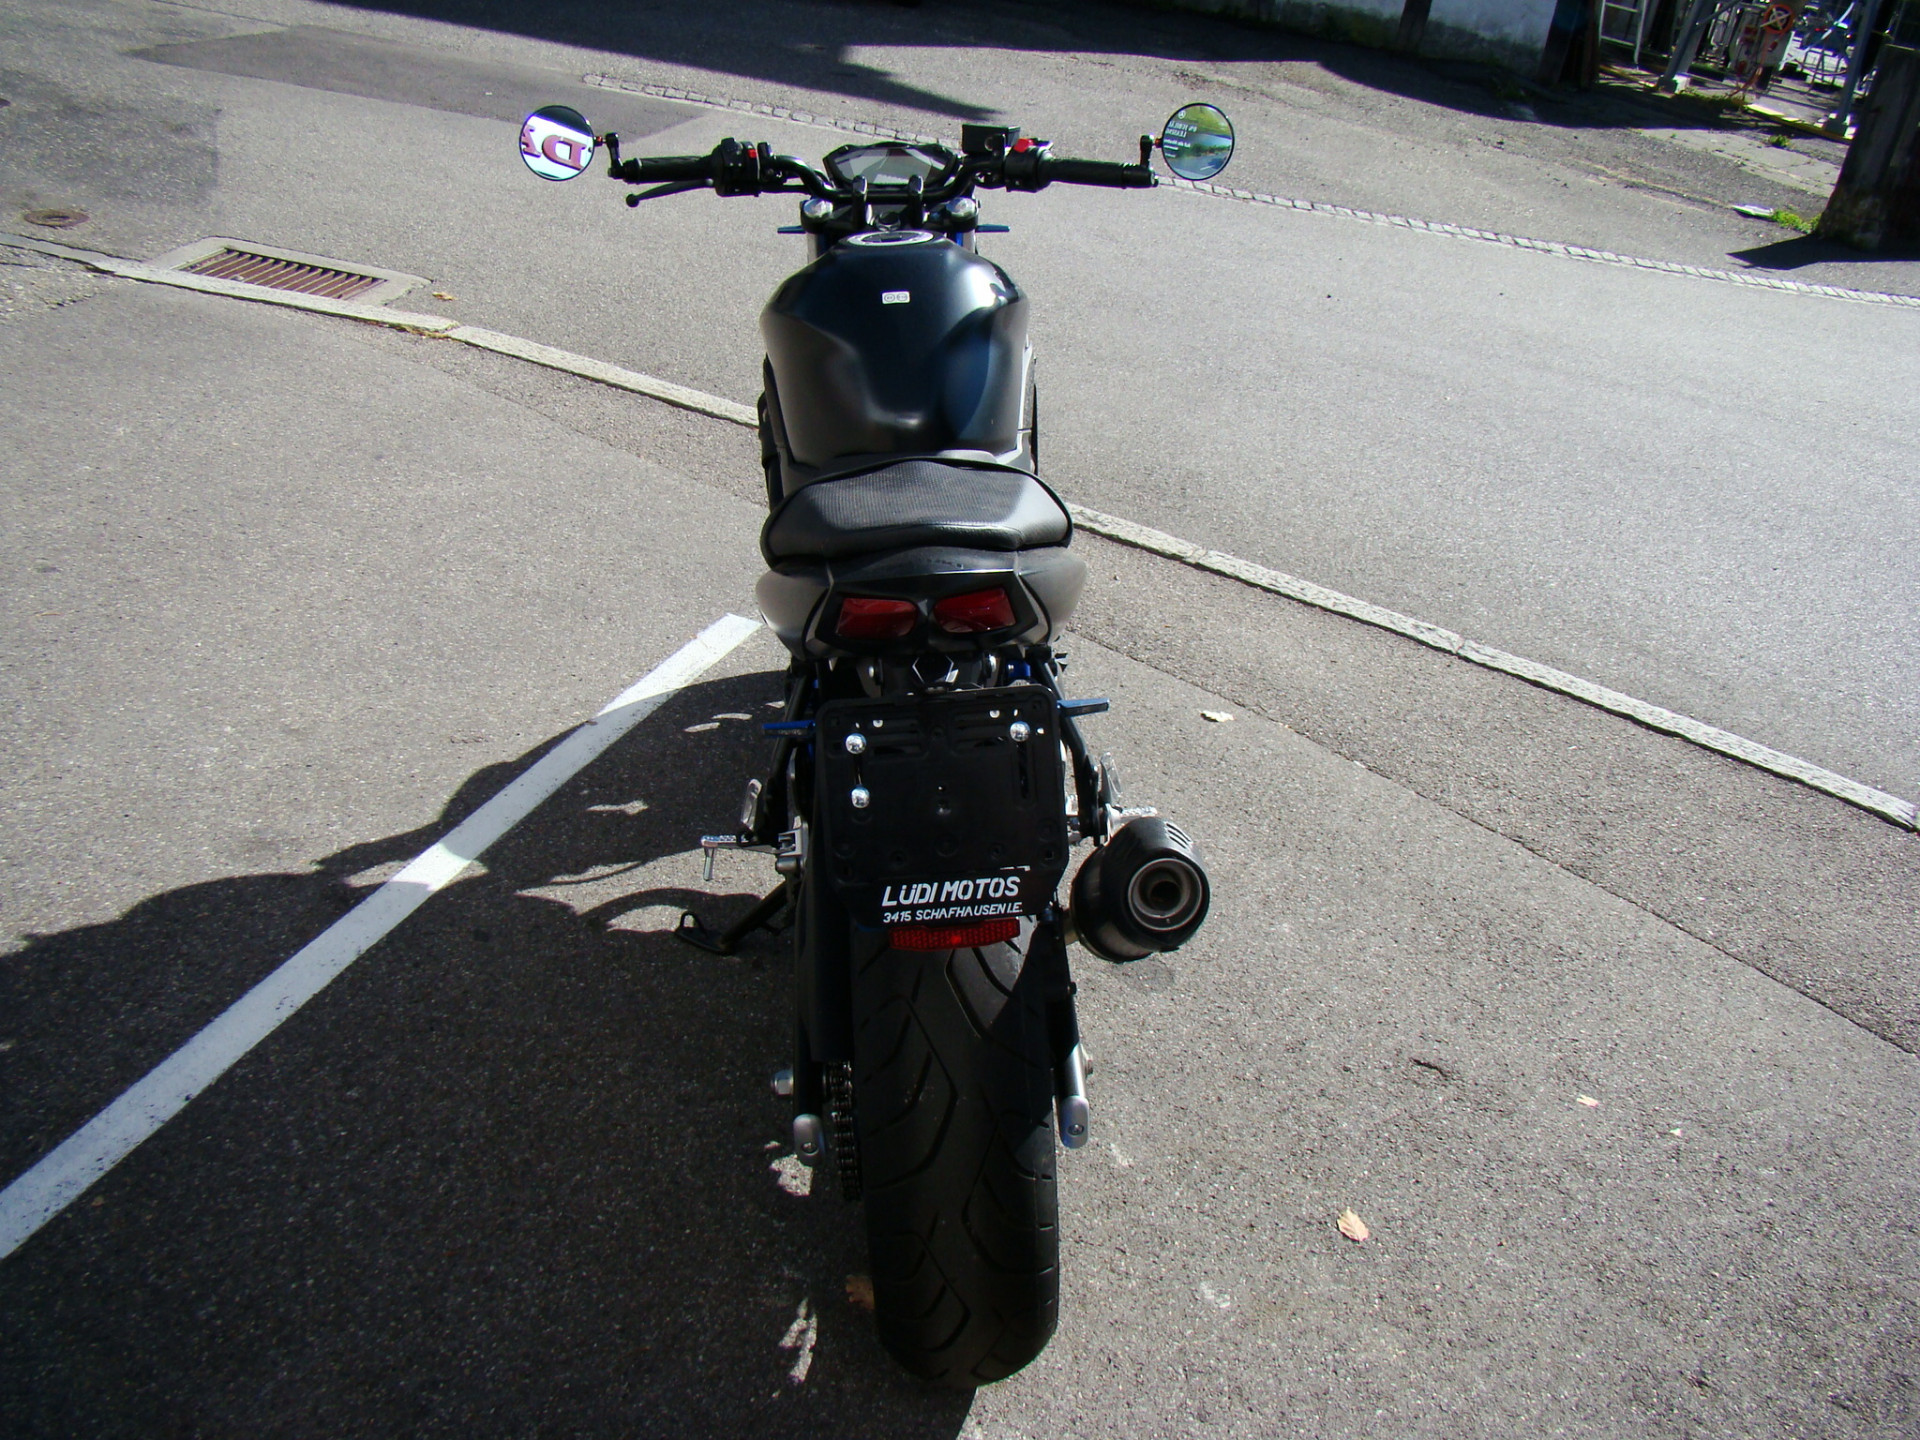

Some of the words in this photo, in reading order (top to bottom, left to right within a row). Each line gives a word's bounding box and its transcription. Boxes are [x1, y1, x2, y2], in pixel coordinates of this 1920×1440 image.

[882, 882, 938, 906] LÜDI
[940, 876, 1021, 902] MOTOS
[883, 910, 912, 923] 3415
[915, 903, 1006, 921] SCHAFHAUSEN
